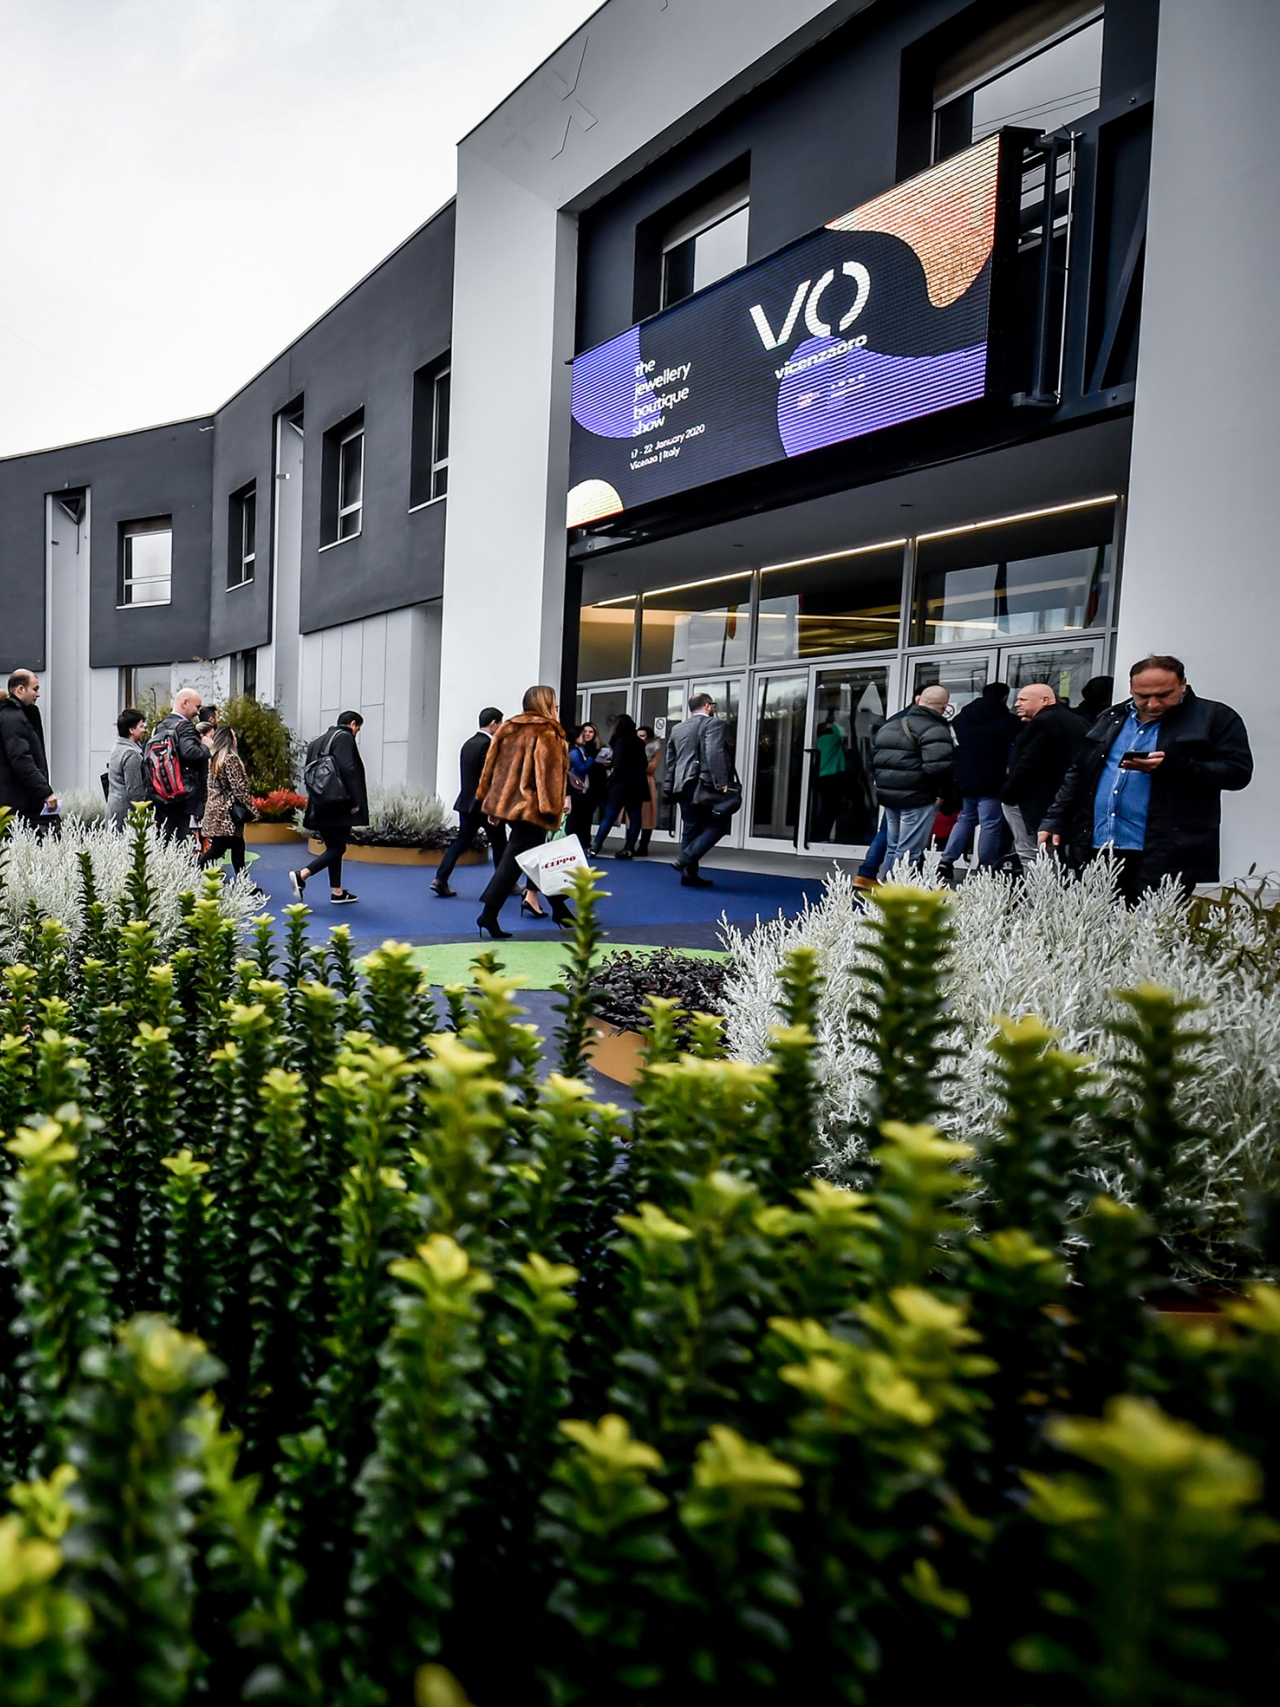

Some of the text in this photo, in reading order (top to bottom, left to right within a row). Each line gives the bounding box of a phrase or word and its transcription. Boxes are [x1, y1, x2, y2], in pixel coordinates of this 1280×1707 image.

[749, 261, 870, 350] VO
[634, 362, 691, 402] jewellery
[635, 360, 656, 377] the
[634, 387, 689, 419] boutique
[632, 416, 665, 437] show
[643, 443, 653, 454] 22
[655, 433, 685, 450] January
[685, 424, 705, 439] 2020
[630, 455, 658, 470] Vicenza
[663, 446, 680, 458] Italy
